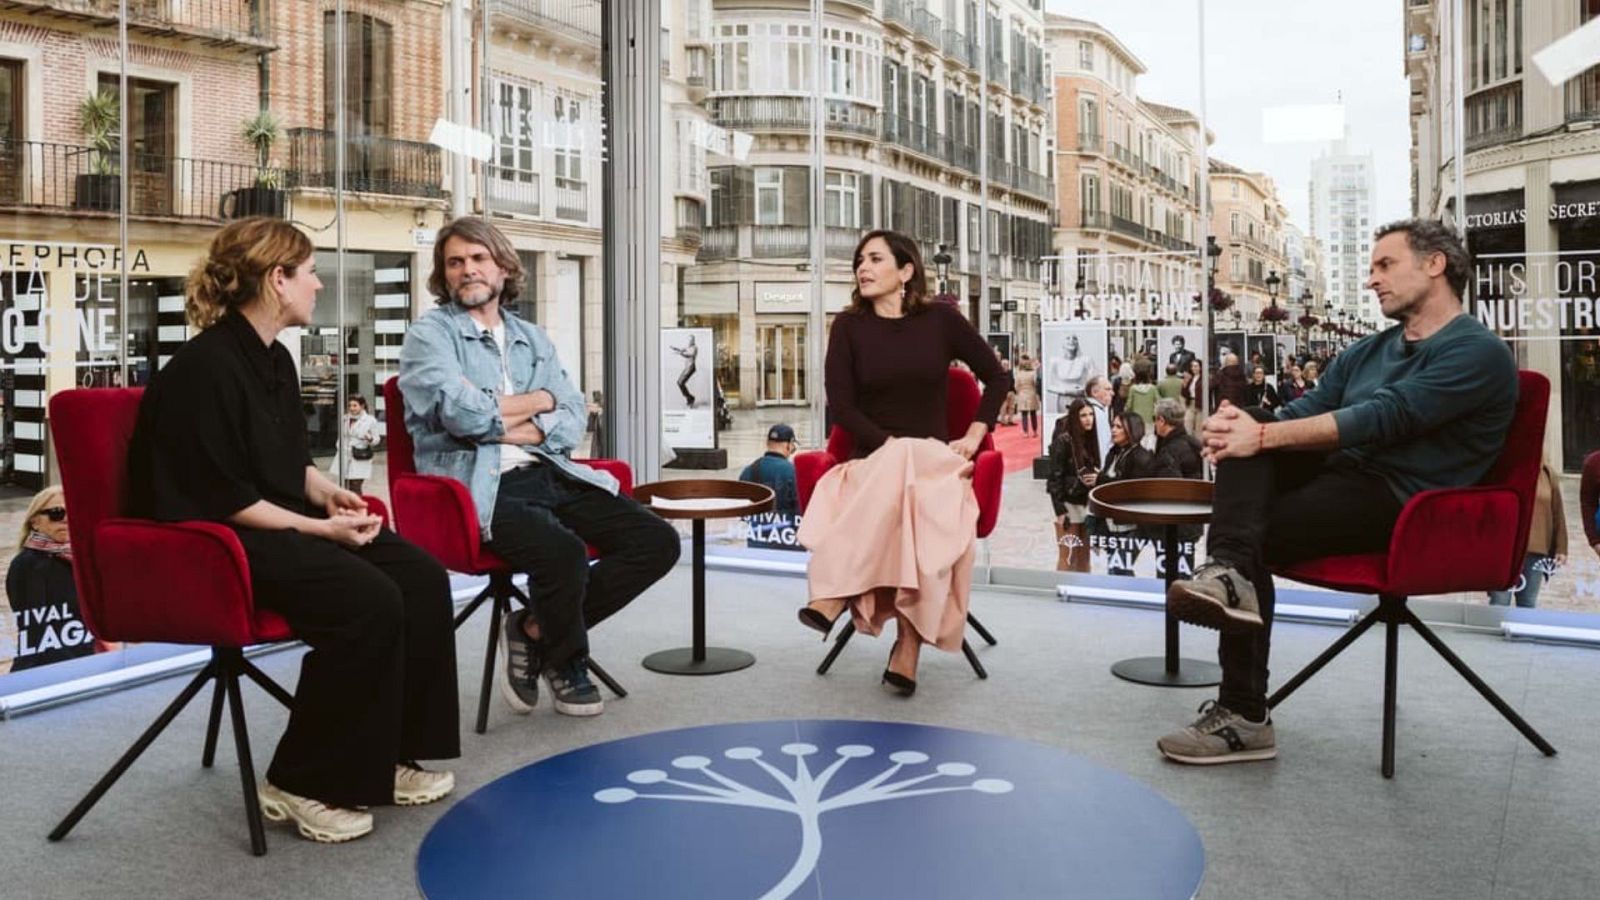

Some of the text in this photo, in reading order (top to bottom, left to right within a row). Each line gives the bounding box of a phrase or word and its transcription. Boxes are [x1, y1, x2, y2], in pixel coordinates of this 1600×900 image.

[1451, 200, 1600, 229] CTORIA'S SECRE
[0, 244, 150, 271] EPHORA
[1476, 260, 1596, 296] HISTOR
[1040, 291, 1200, 321] NUESTRO CINE
[1476, 296, 1600, 331] NUESTR
[745, 520, 801, 546] ALAG
[1089, 535, 1166, 552] FESTIVAL
